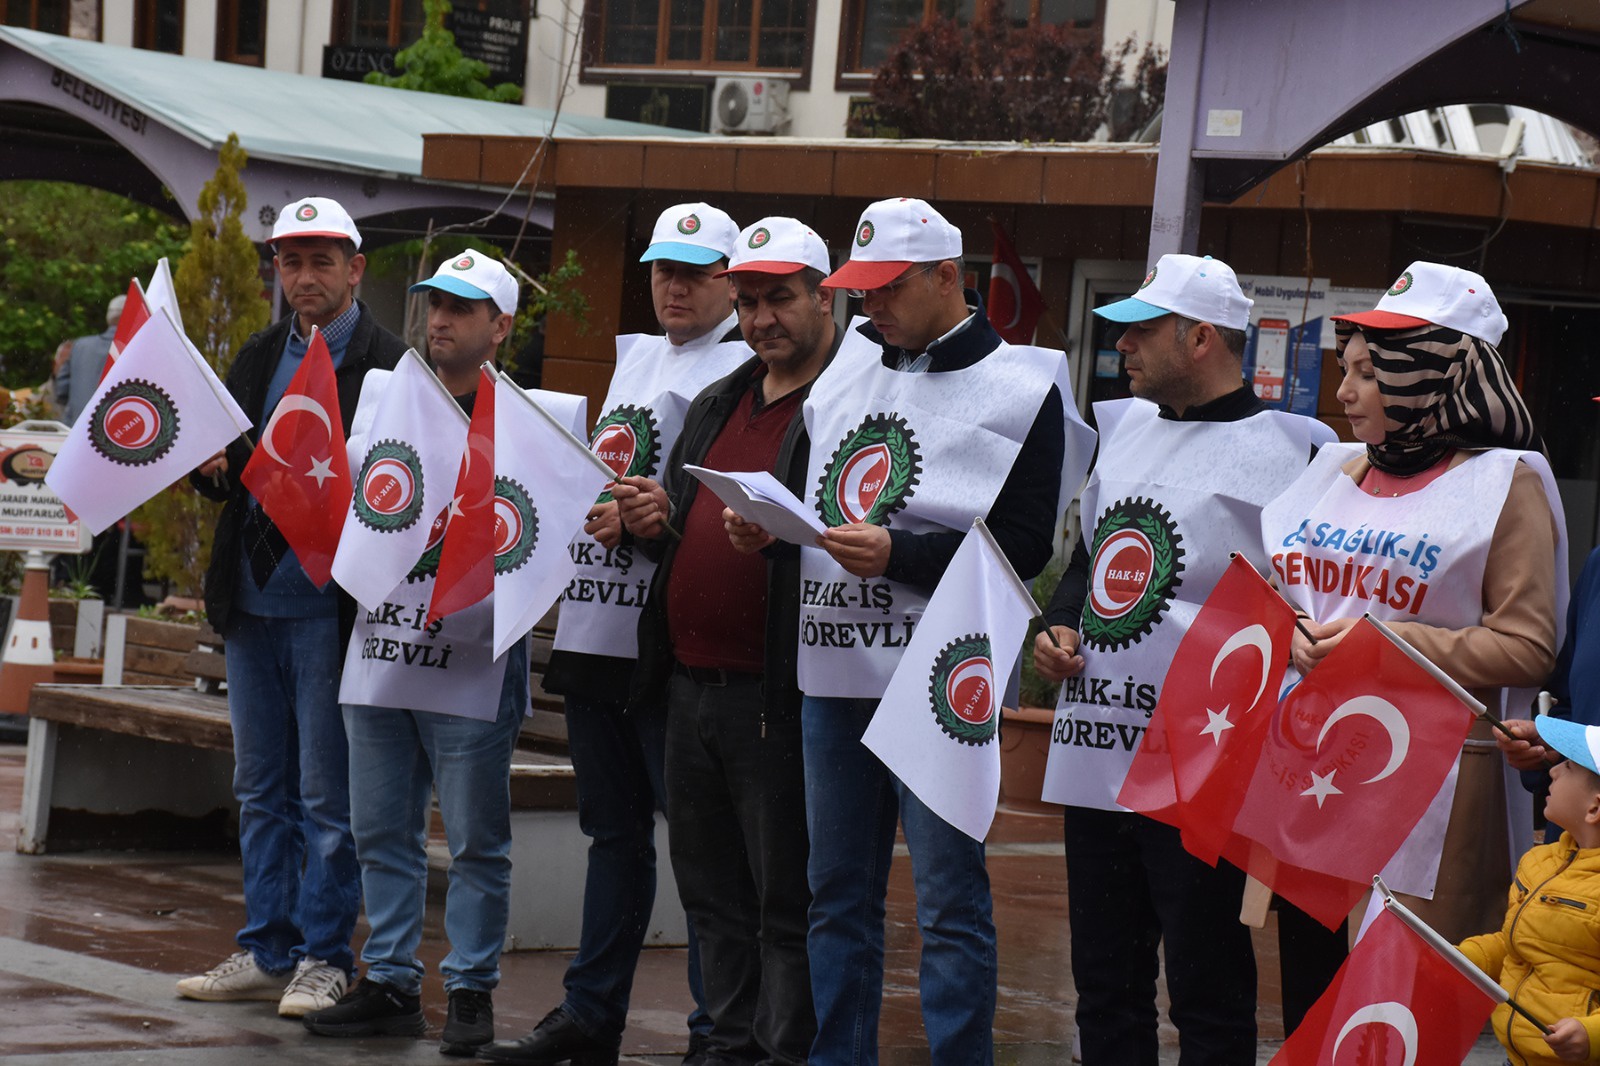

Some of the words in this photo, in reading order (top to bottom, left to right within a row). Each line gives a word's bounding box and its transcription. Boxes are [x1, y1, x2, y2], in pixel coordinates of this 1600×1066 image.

[489, 16, 522, 34] PROJE
[1255, 286, 1276, 297] Mobil
[1311, 522, 1442, 579] SAĞLIK-İŞ
[1107, 569, 1145, 585] HAK-İŞ
[1271, 552, 1429, 615] SENDİKASI
[802, 578, 894, 615] HAK-İŞ
[801, 614, 915, 648] GÖREVLİ
[1065, 675, 1157, 718] HAK-İŞ
